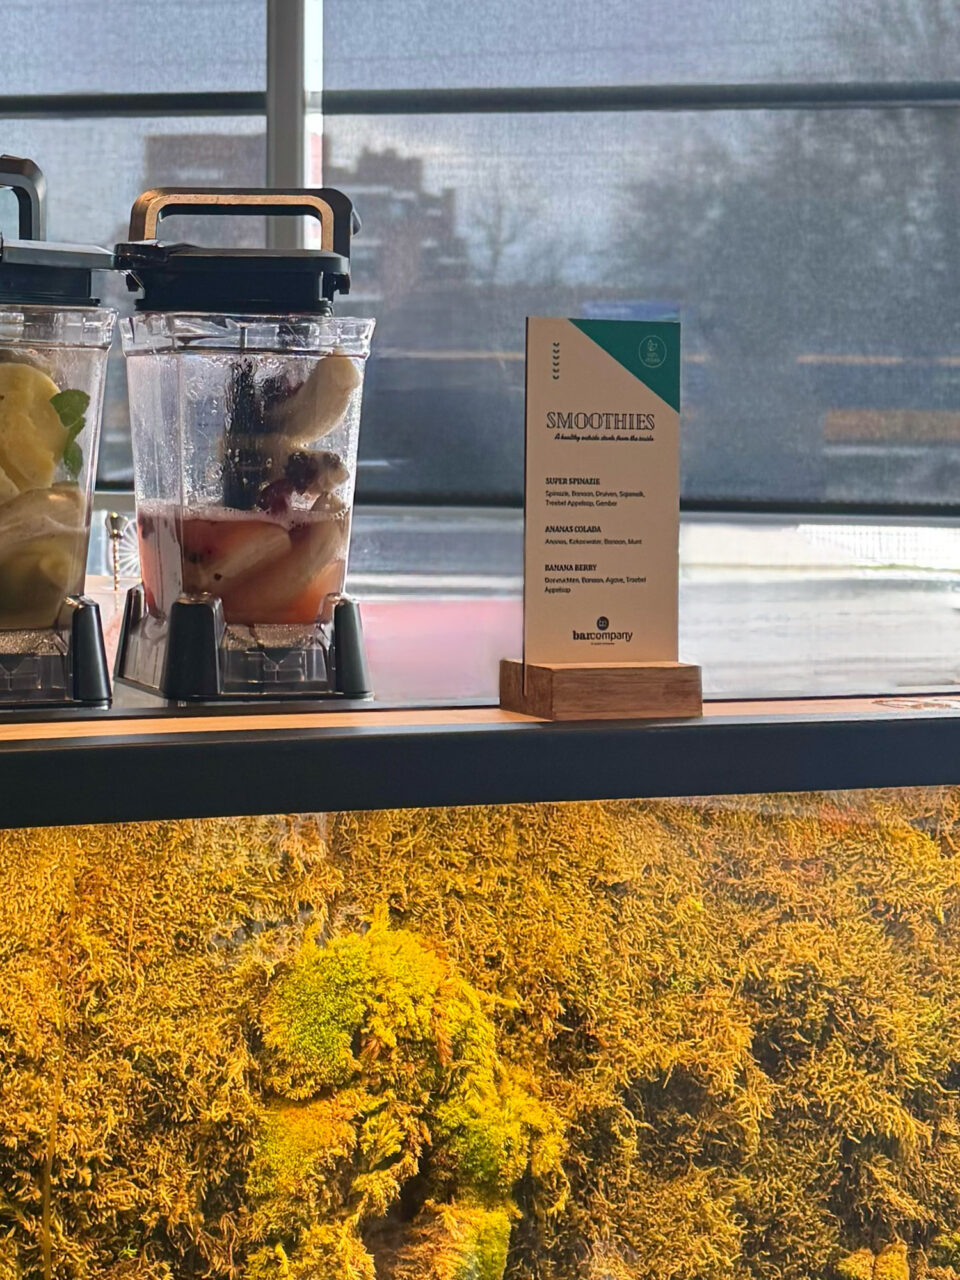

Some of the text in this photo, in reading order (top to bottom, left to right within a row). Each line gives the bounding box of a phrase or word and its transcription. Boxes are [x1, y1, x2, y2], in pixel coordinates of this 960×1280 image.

[546, 411, 655, 431] SMOOTHIES
[561, 434, 581, 442] healthy
[545, 477, 600, 485] SUPER SPINAZIE
[545, 525, 601, 533] ANANAS COLADA
[544, 564, 597, 572] BANANA BERRY
[572, 629, 633, 643] barcompany
